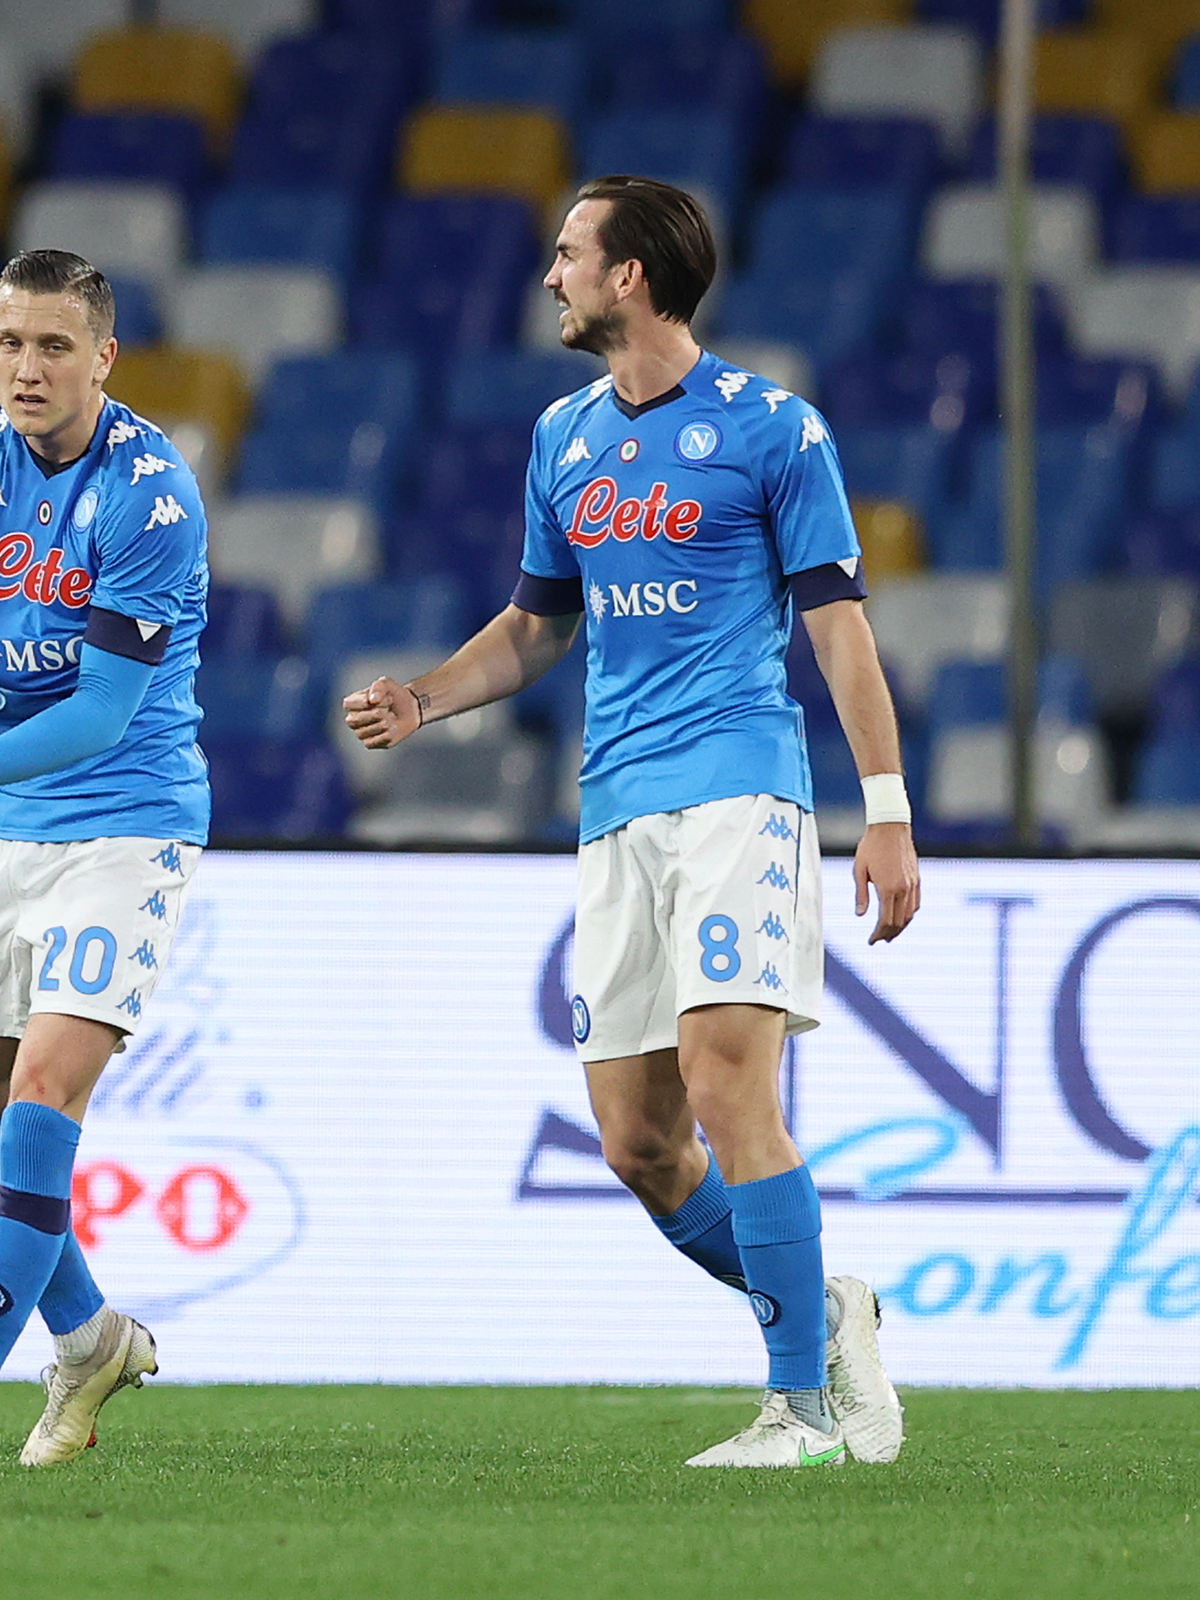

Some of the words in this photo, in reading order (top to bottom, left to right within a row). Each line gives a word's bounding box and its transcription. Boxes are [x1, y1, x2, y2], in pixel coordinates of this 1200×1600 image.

[567, 475, 702, 549] Lete
[608, 579, 699, 617] MSC
[38, 925, 118, 995] 20
[697, 914, 742, 982] 8
